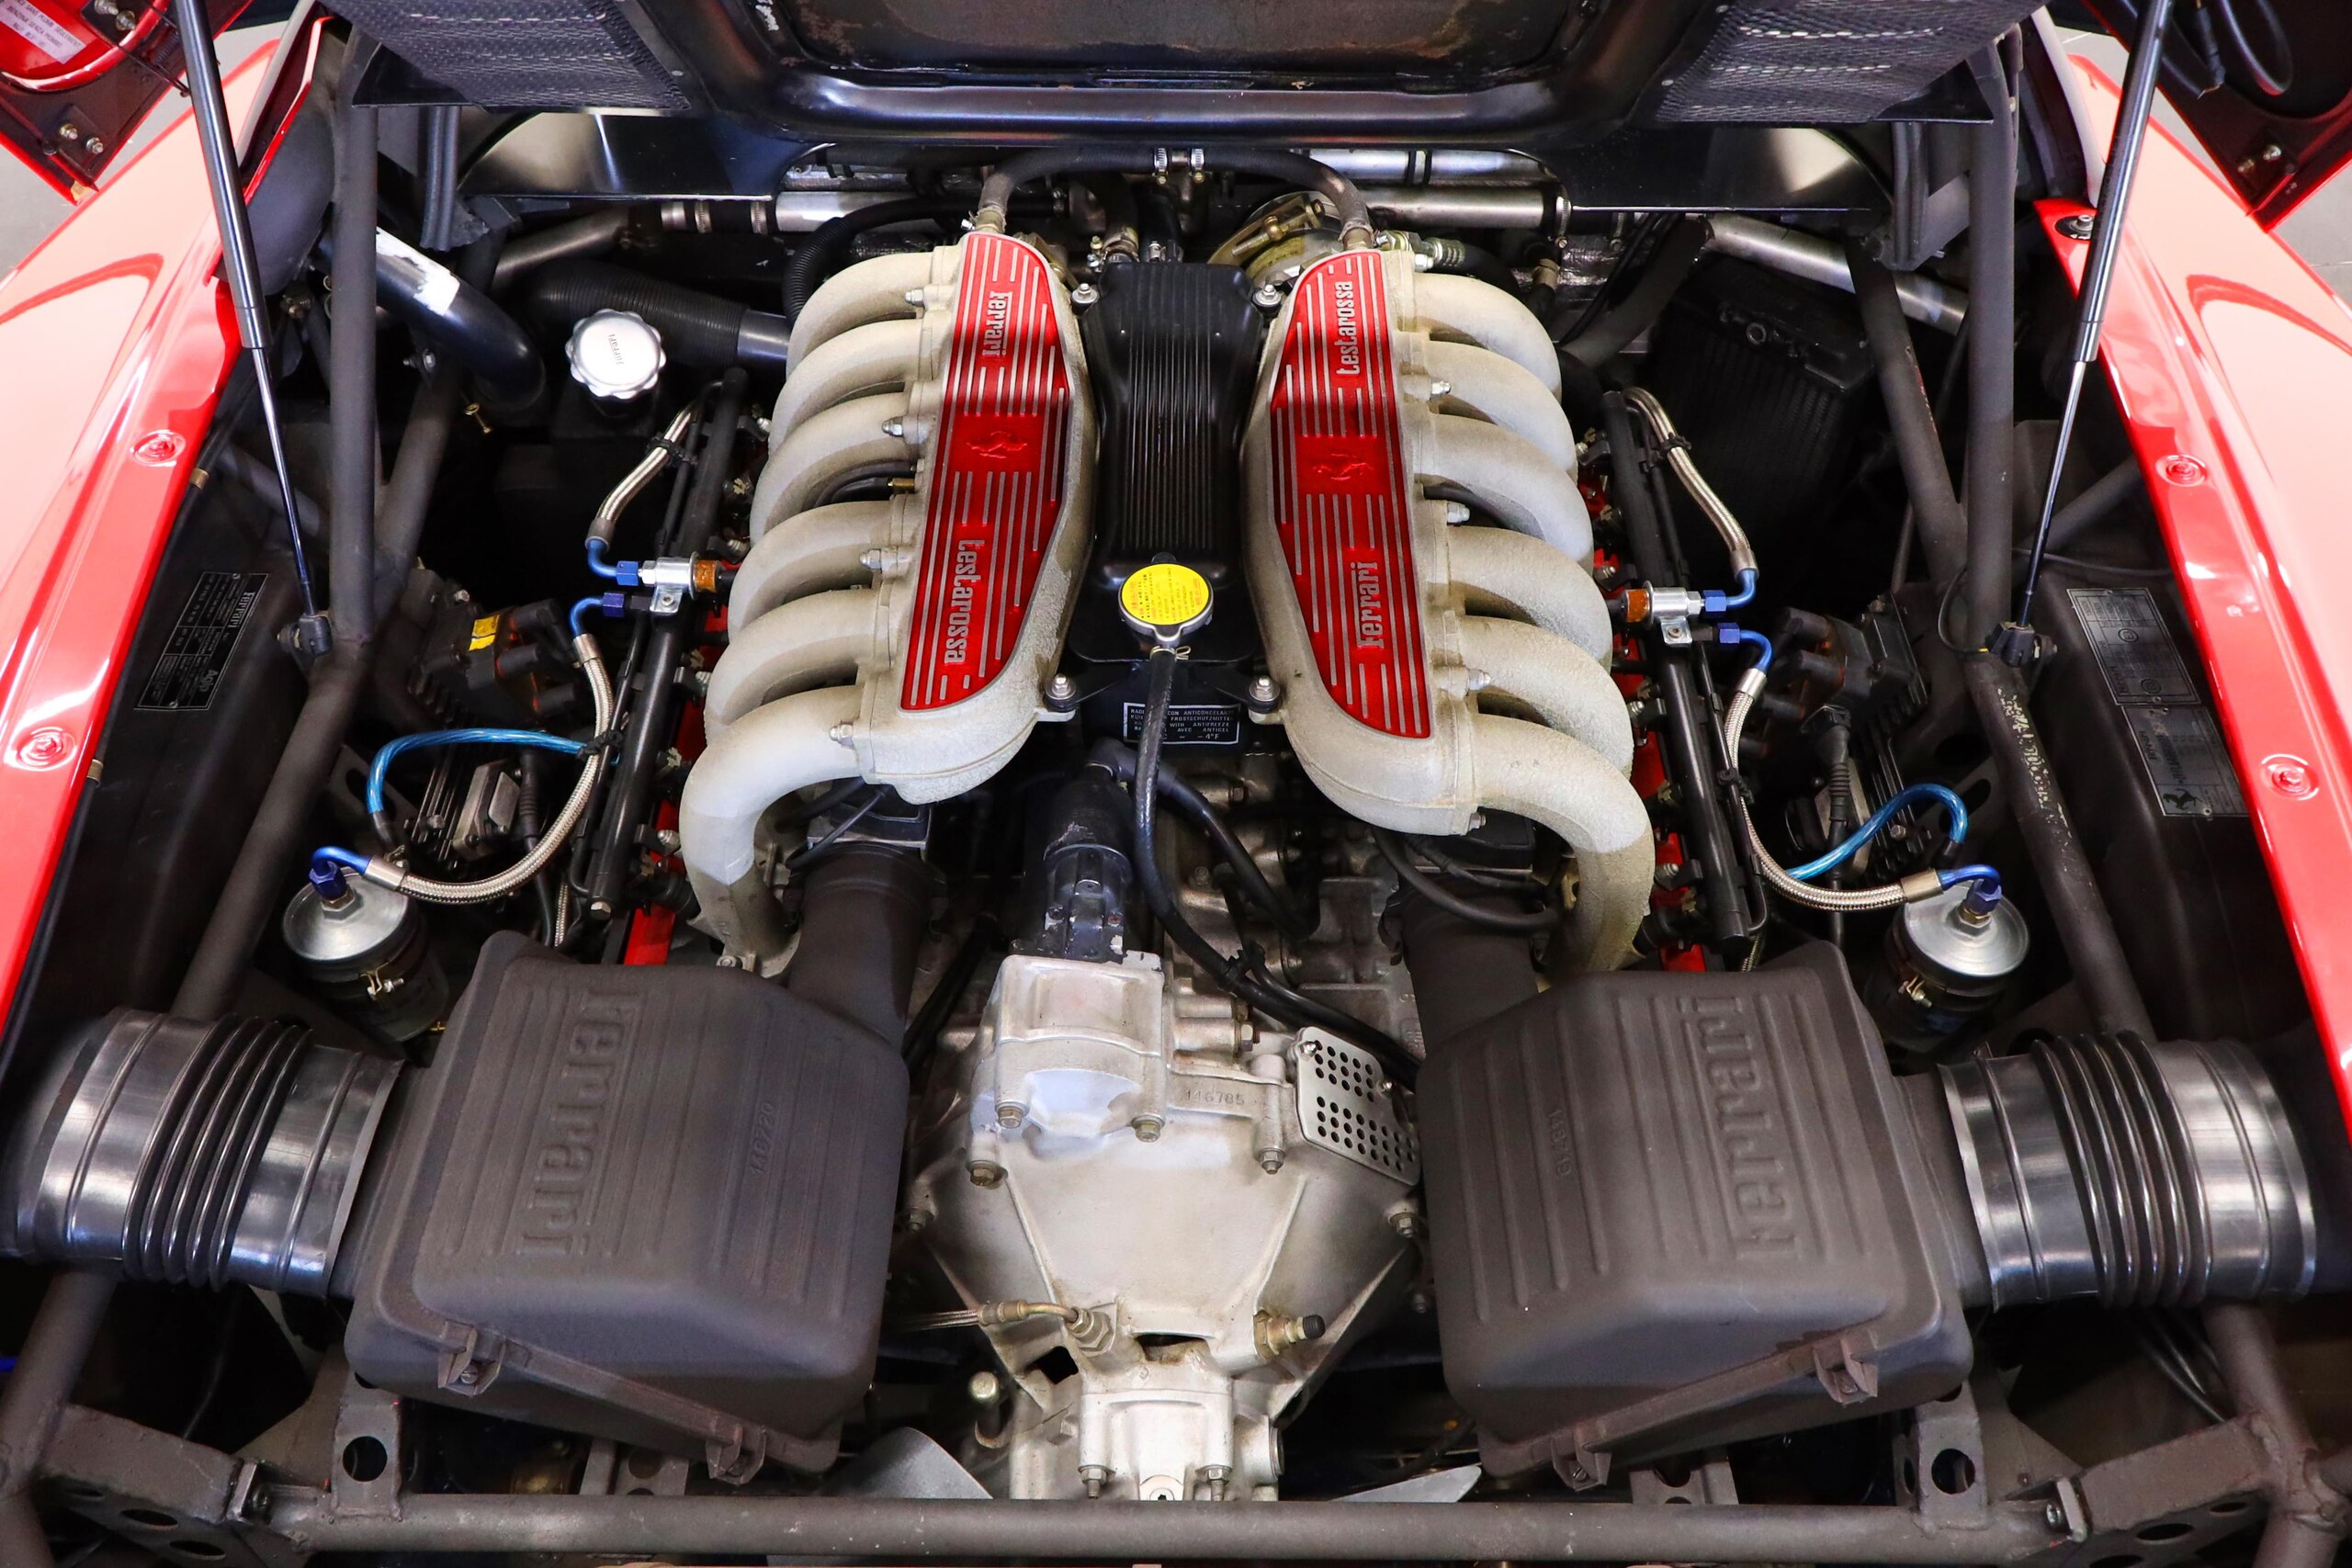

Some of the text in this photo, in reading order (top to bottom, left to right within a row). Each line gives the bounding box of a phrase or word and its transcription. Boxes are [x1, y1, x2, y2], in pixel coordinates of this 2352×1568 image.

[982, 291, 1012, 356] Ferrari
[1334, 281, 1361, 375] testarossa
[228, 592, 256, 628] Ferrari
[944, 539, 986, 665] testarossa
[1350, 561, 1385, 649] Ferrari
[199, 669, 219, 693] Agip
[514, 987, 643, 1256] Ferrari
[1676, 996, 1801, 1260] Ferrari
